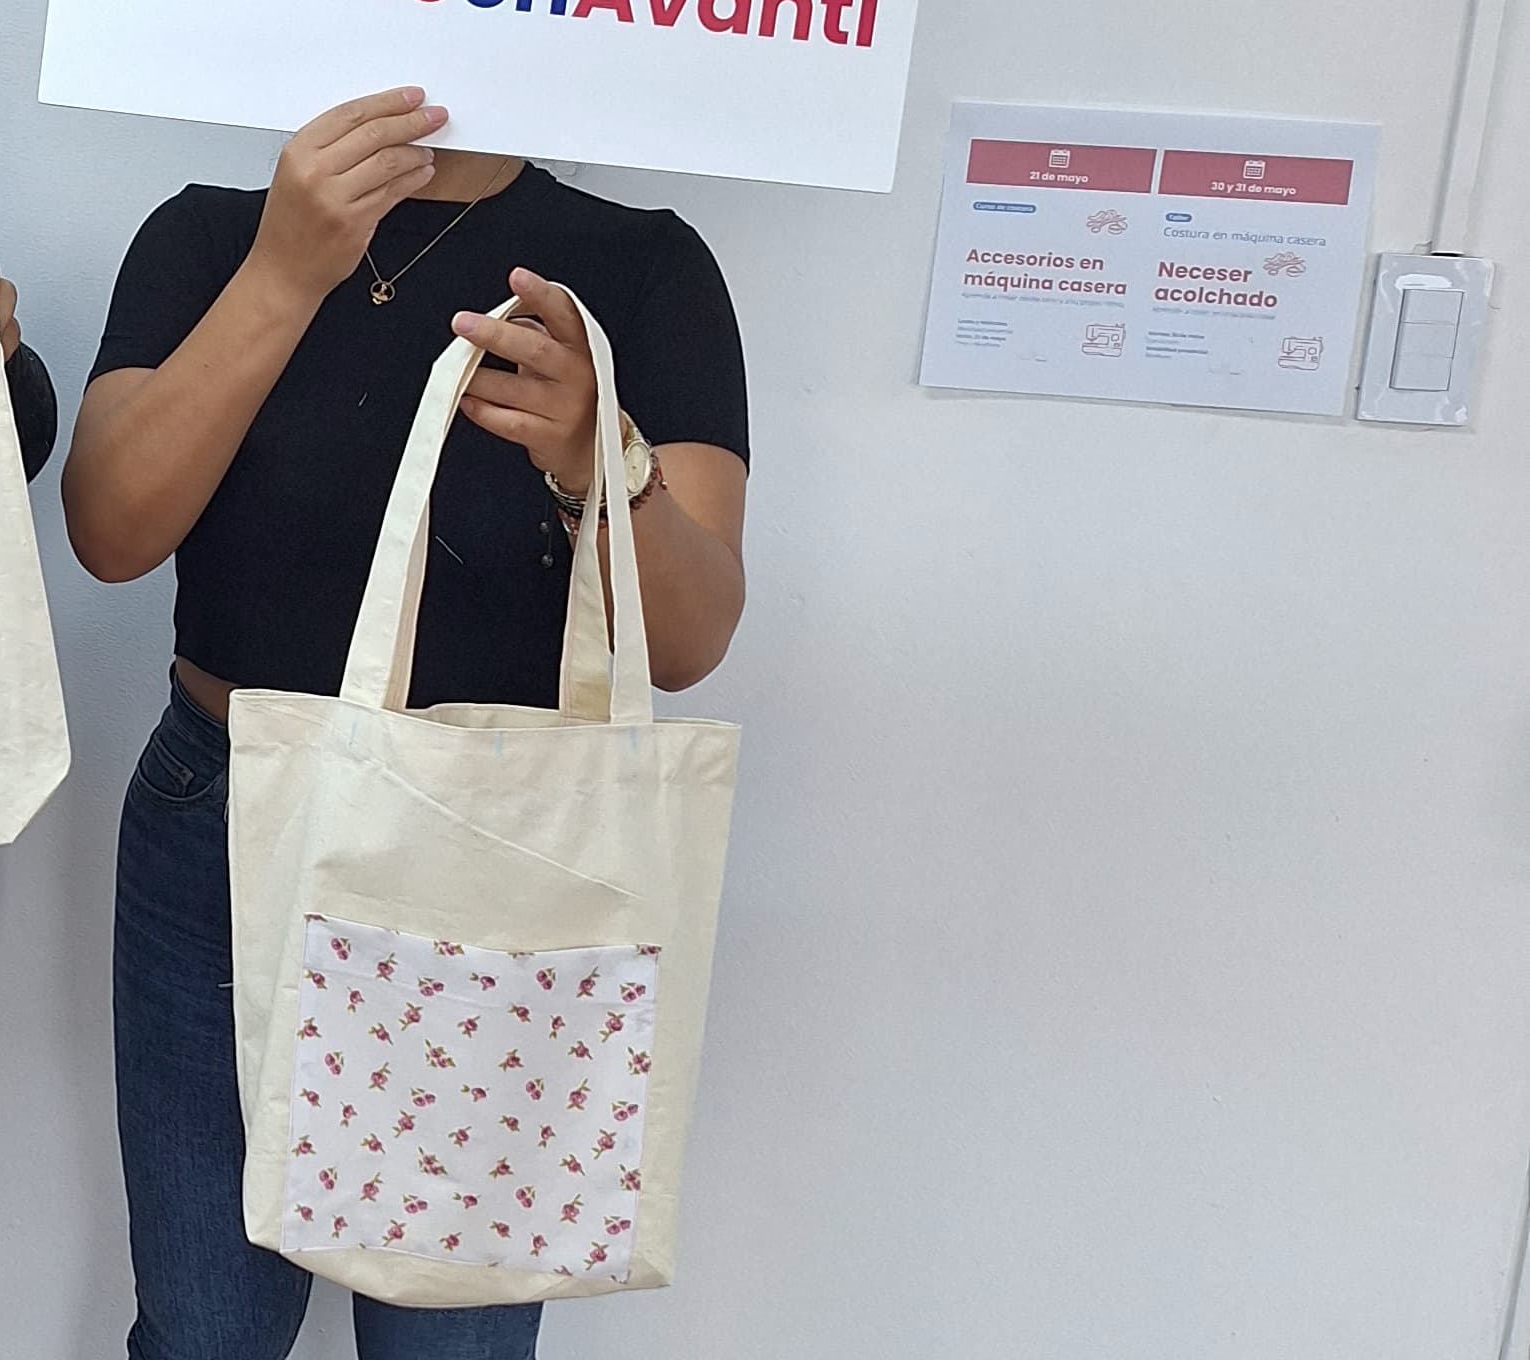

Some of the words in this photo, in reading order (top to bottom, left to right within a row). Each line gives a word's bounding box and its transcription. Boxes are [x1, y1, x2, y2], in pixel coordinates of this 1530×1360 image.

[1029, 171, 1040, 181] 21
[1041, 171, 1055, 181] de
[1057, 173, 1089, 185] mayo
[1226, 184, 1233, 194] y
[1248, 183, 1261, 193] de
[1264, 185, 1297, 198] mayo
[1163, 226, 1210, 240] Costura
[1213, 232, 1227, 241] en
[1287, 236, 1327, 247] casera
[966, 248, 1075, 269] Accesorios
[1079, 258, 1105, 271] en
[963, 271, 1054, 293] máquina
[1058, 278, 1128, 295] casera
[1158, 261, 1253, 283] Neceser
[1154, 286, 1278, 308] acolchado
